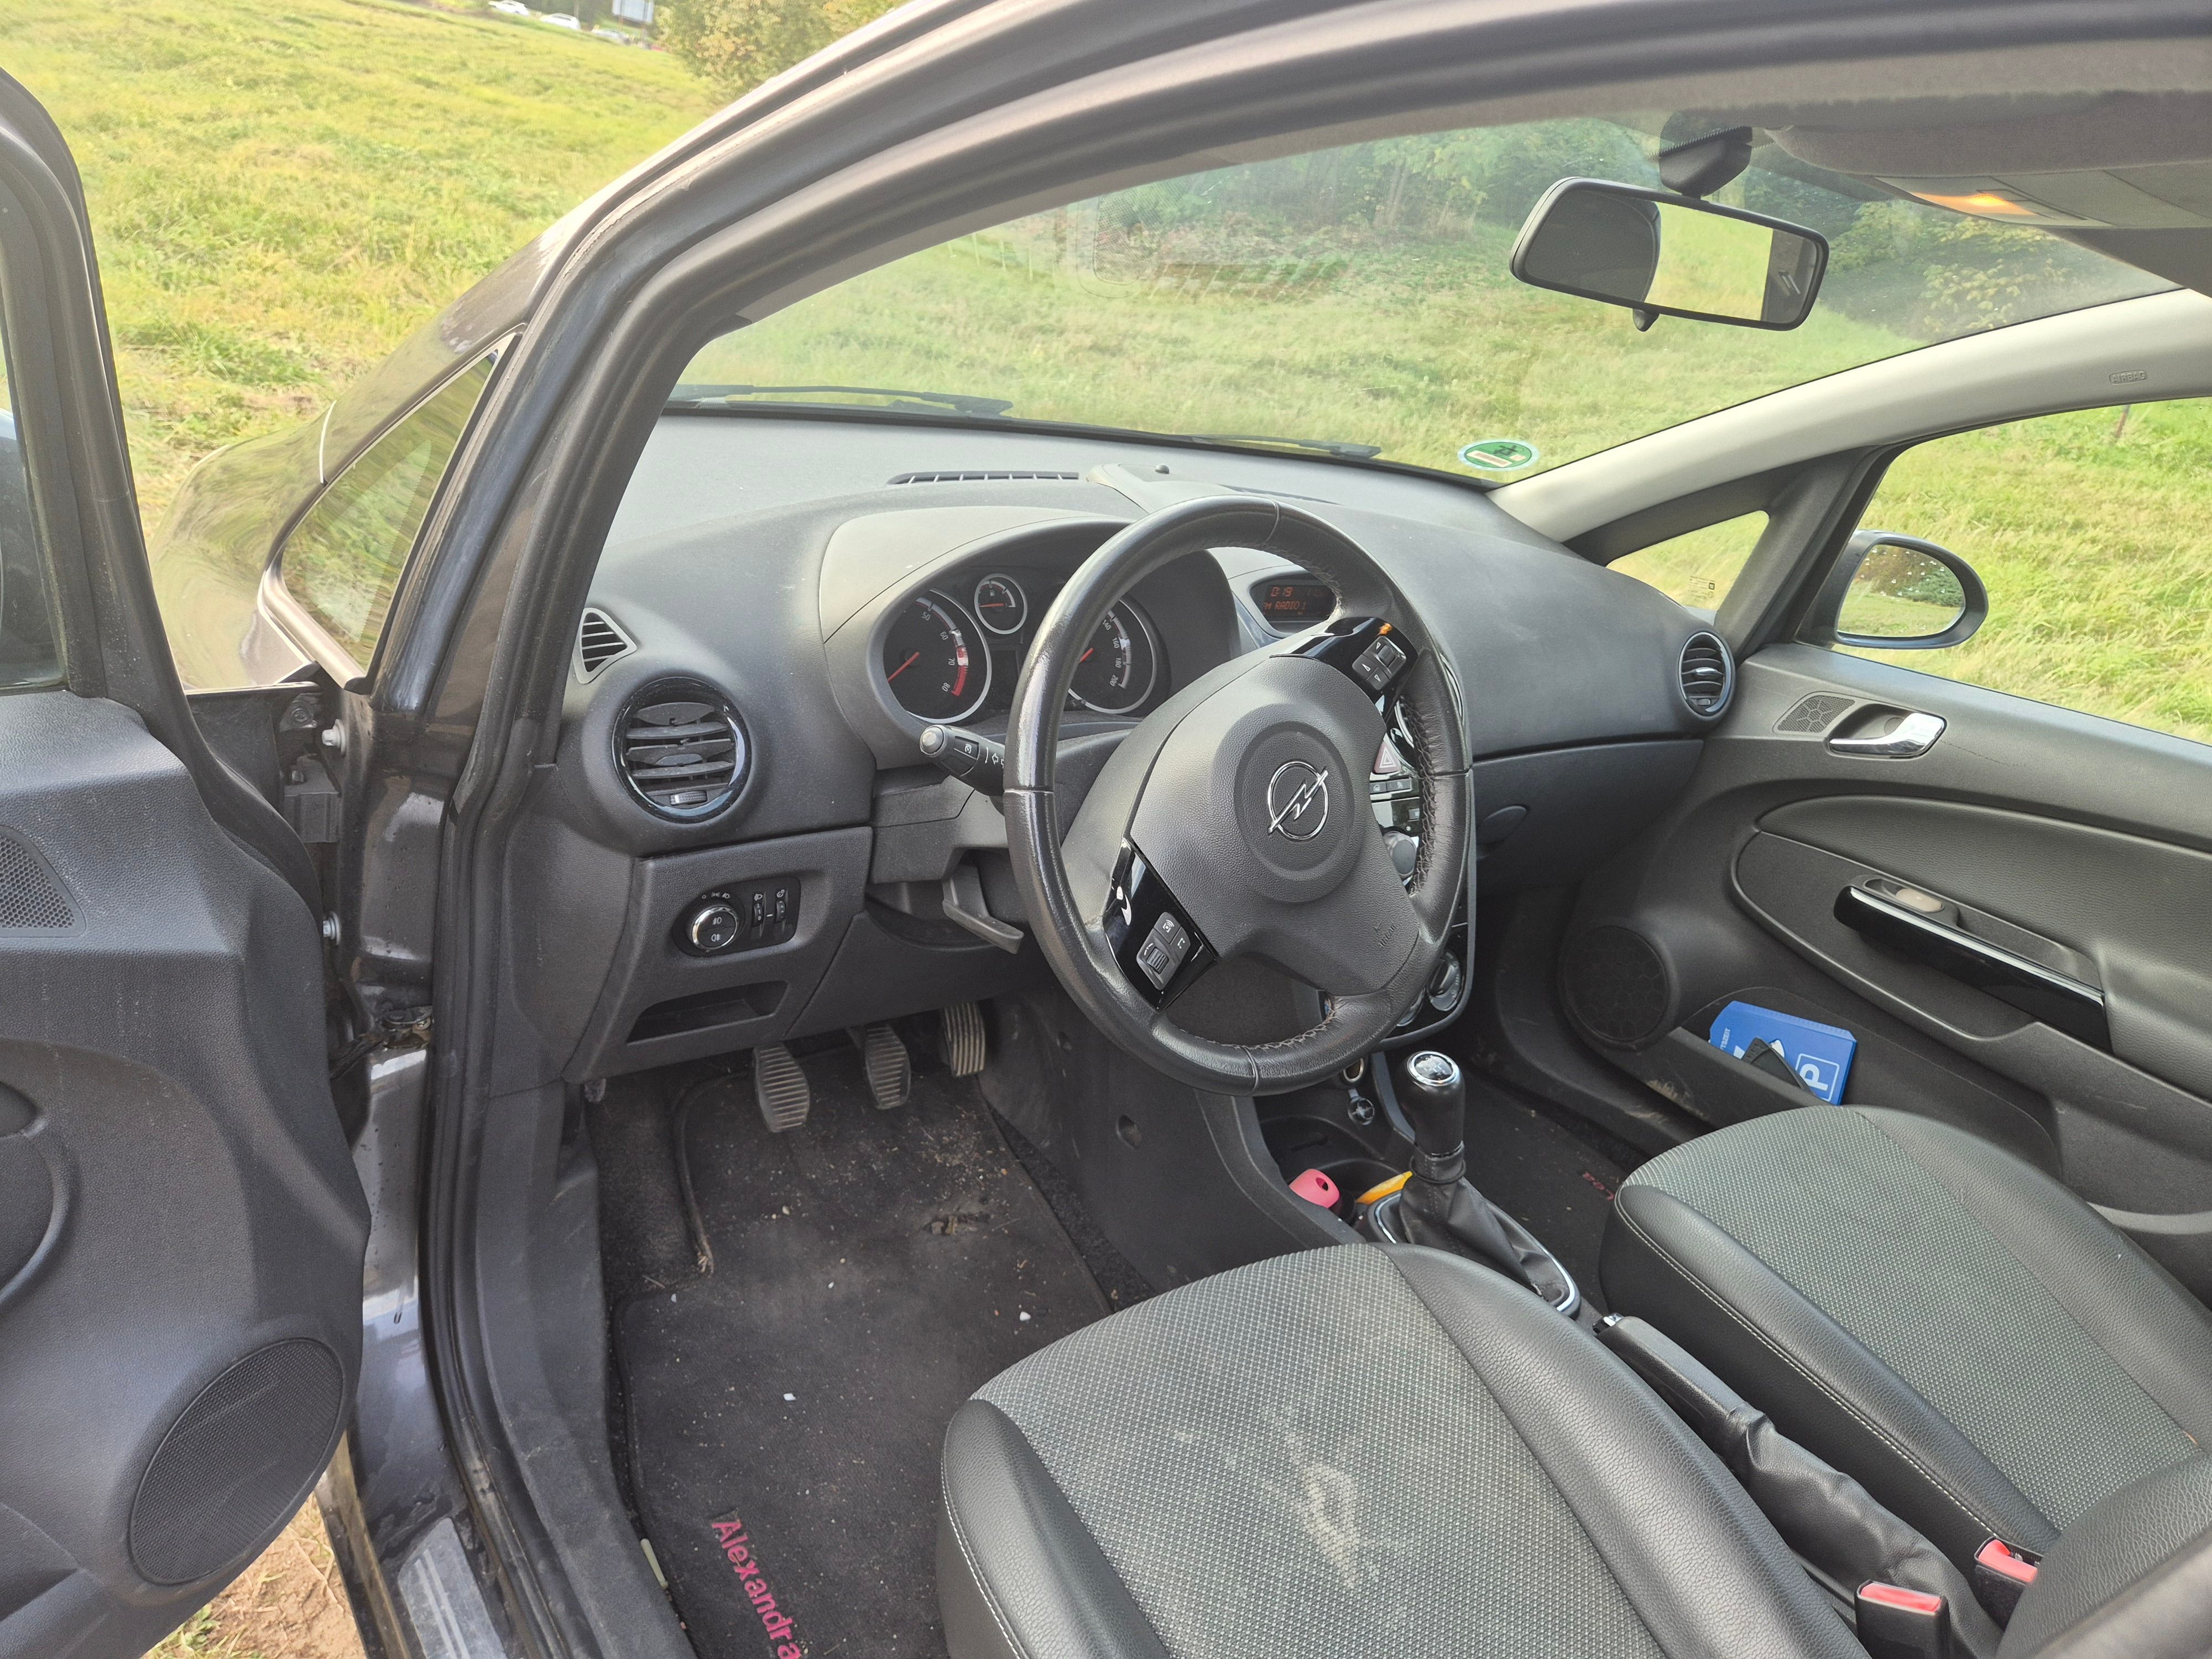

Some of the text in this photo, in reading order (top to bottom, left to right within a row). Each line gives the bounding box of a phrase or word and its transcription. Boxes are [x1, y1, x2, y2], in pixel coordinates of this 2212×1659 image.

[1274, 601, 1301, 610] RADIO
[922, 612, 931, 620] 50
[1102, 619, 1112, 630] 140
[940, 631, 949, 640] 60
[948, 658, 956, 666] 70
[1109, 674, 1118, 686] 200
[942, 682, 951, 692] 80
[1800, 1063, 1828, 1091] P
[712, 1521, 802, 1659] Alexandra
